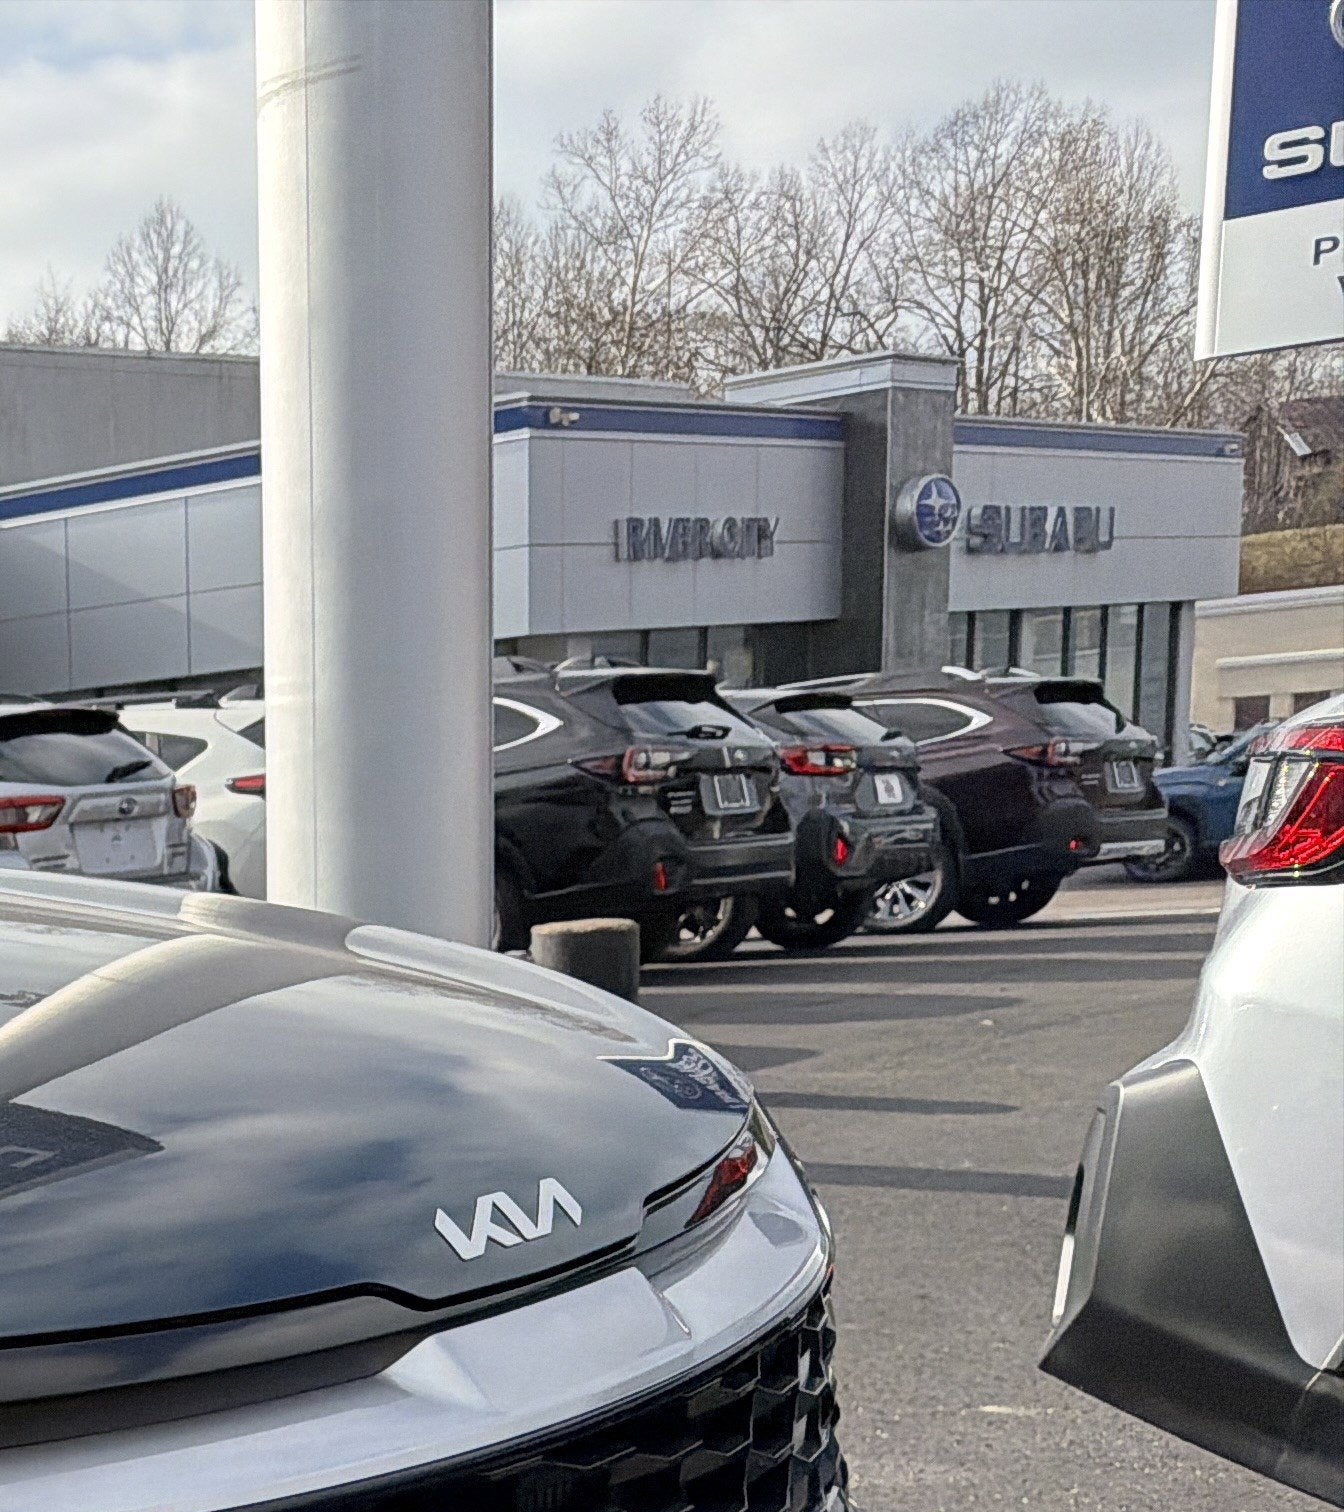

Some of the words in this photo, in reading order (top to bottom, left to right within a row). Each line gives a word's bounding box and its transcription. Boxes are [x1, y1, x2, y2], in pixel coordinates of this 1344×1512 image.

[1262, 120, 1344, 180] S
[613, 517, 712, 562] RIVER
[965, 504, 1116, 554] SUBARU
[434, 1177, 583, 1261] KIA
